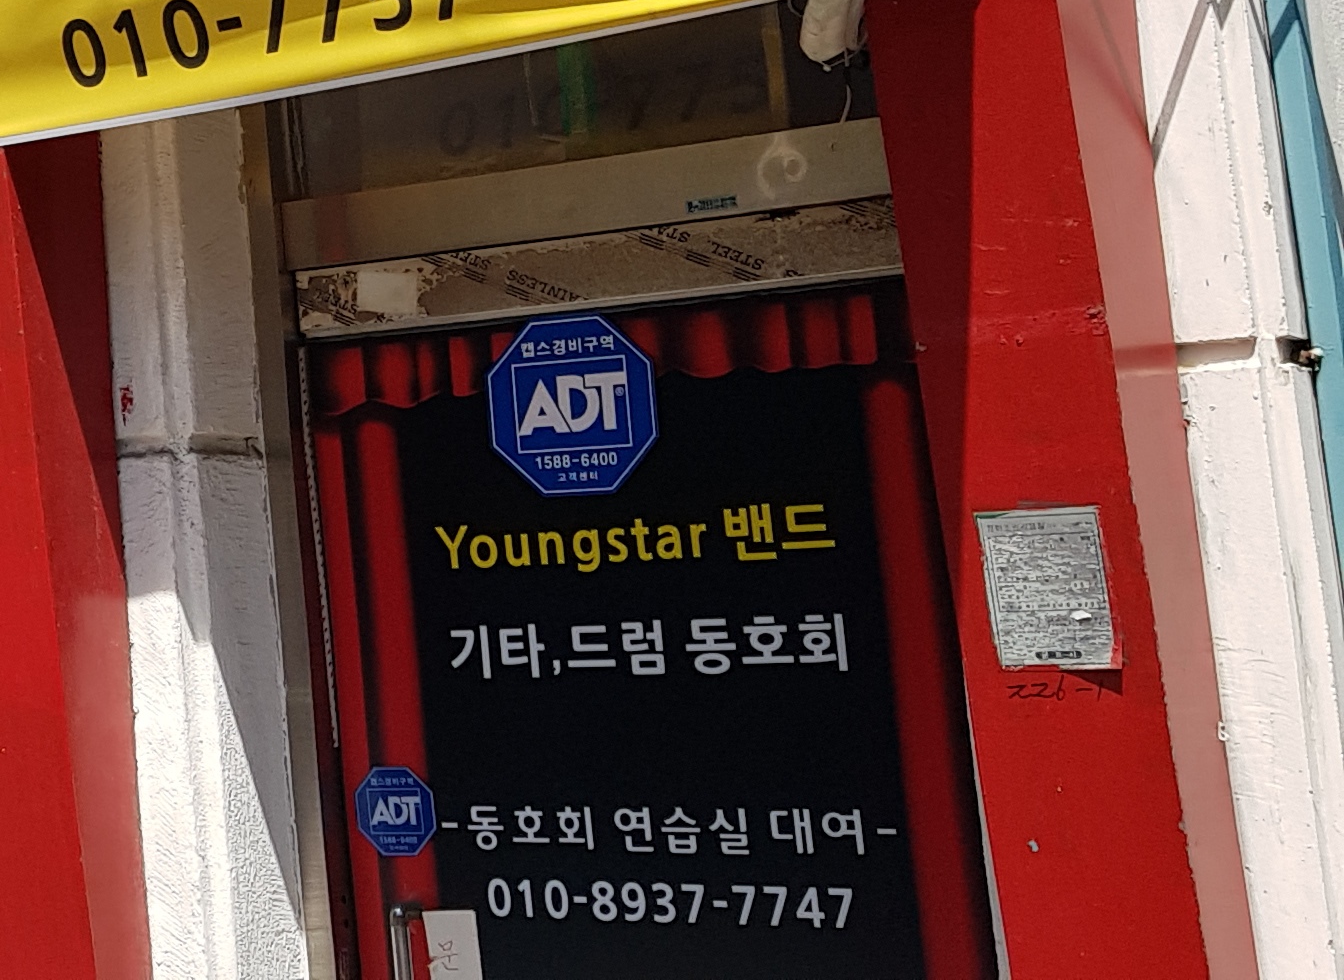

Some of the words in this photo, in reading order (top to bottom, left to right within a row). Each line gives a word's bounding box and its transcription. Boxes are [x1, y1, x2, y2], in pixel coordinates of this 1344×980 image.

[506, 269, 590, 302] AINLESS
[521, 335, 614, 358] 캡스경비구역
[519, 371, 627, 436] ADT
[535, 452, 618, 469] 1588-6400
[434, 518, 707, 572] Youngstar
[723, 503, 836, 561] 밴드
[450, 619, 666, 679] 기타,드럼
[685, 613, 849, 675] 동호회
[371, 796, 421, 826] ADT
[614, 806, 750, 856] 연습실
[487, 878, 854, 929] 010-8937-7747
